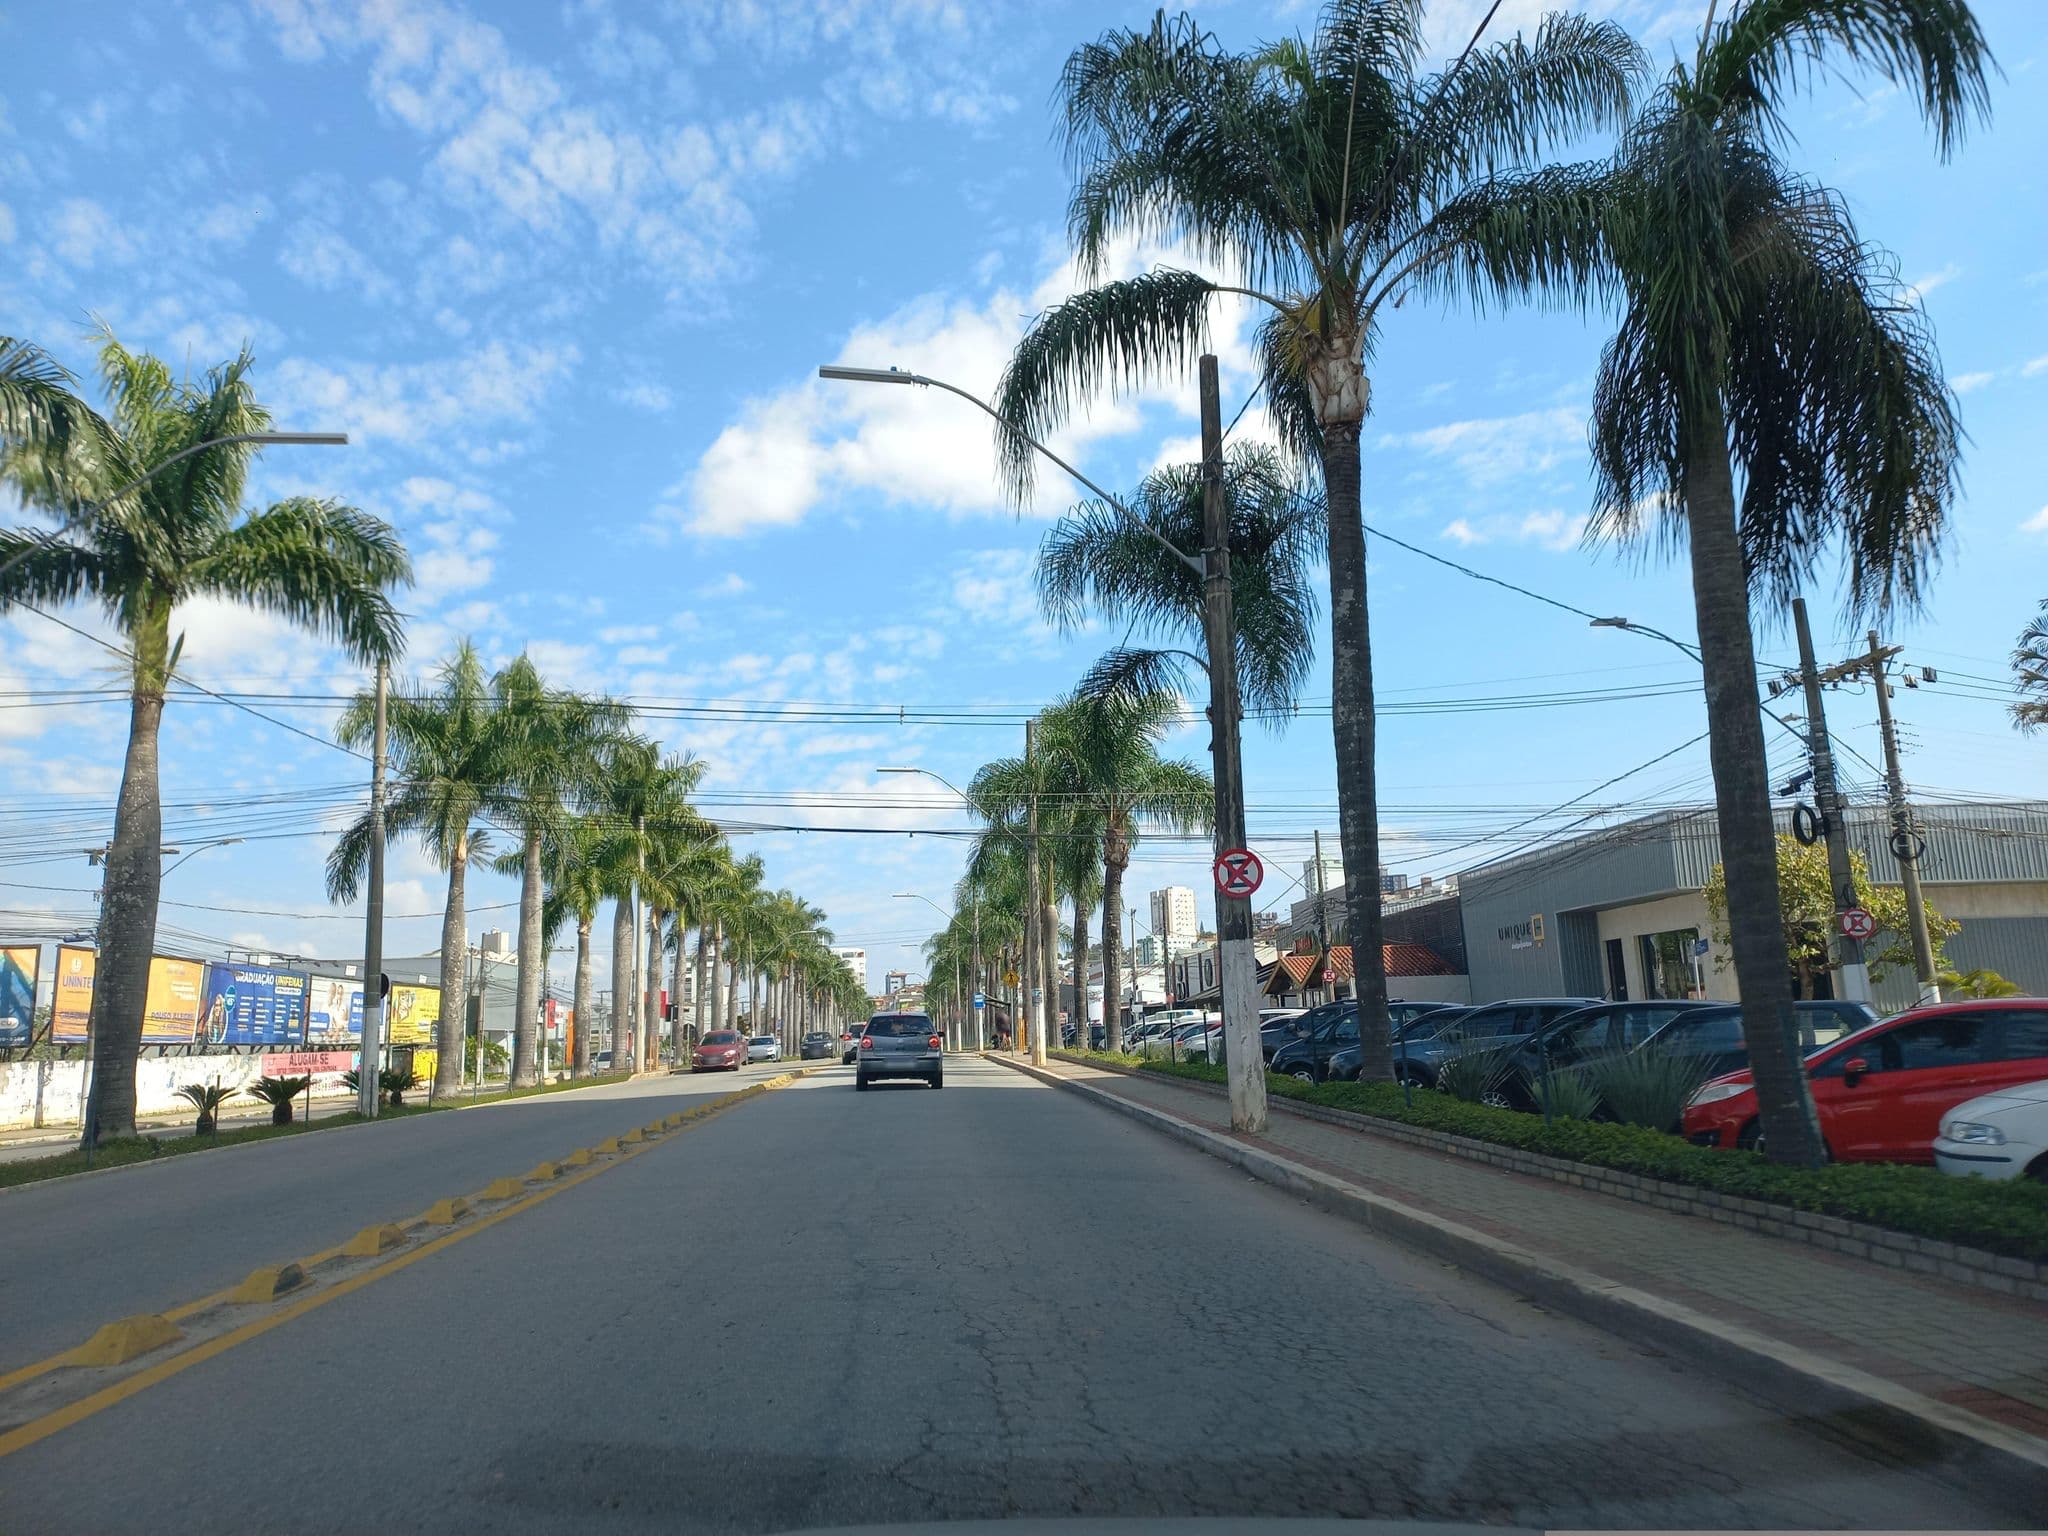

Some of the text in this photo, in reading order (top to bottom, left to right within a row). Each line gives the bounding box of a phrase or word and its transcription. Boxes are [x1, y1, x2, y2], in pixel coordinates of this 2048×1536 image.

[1497, 920, 1530, 941] UNIQUE
[62, 975, 93, 989] UNINTE
[234, 971, 275, 988] GRADUAÇÃO
[289, 1053, 329, 1067] ALUGAM-SE
